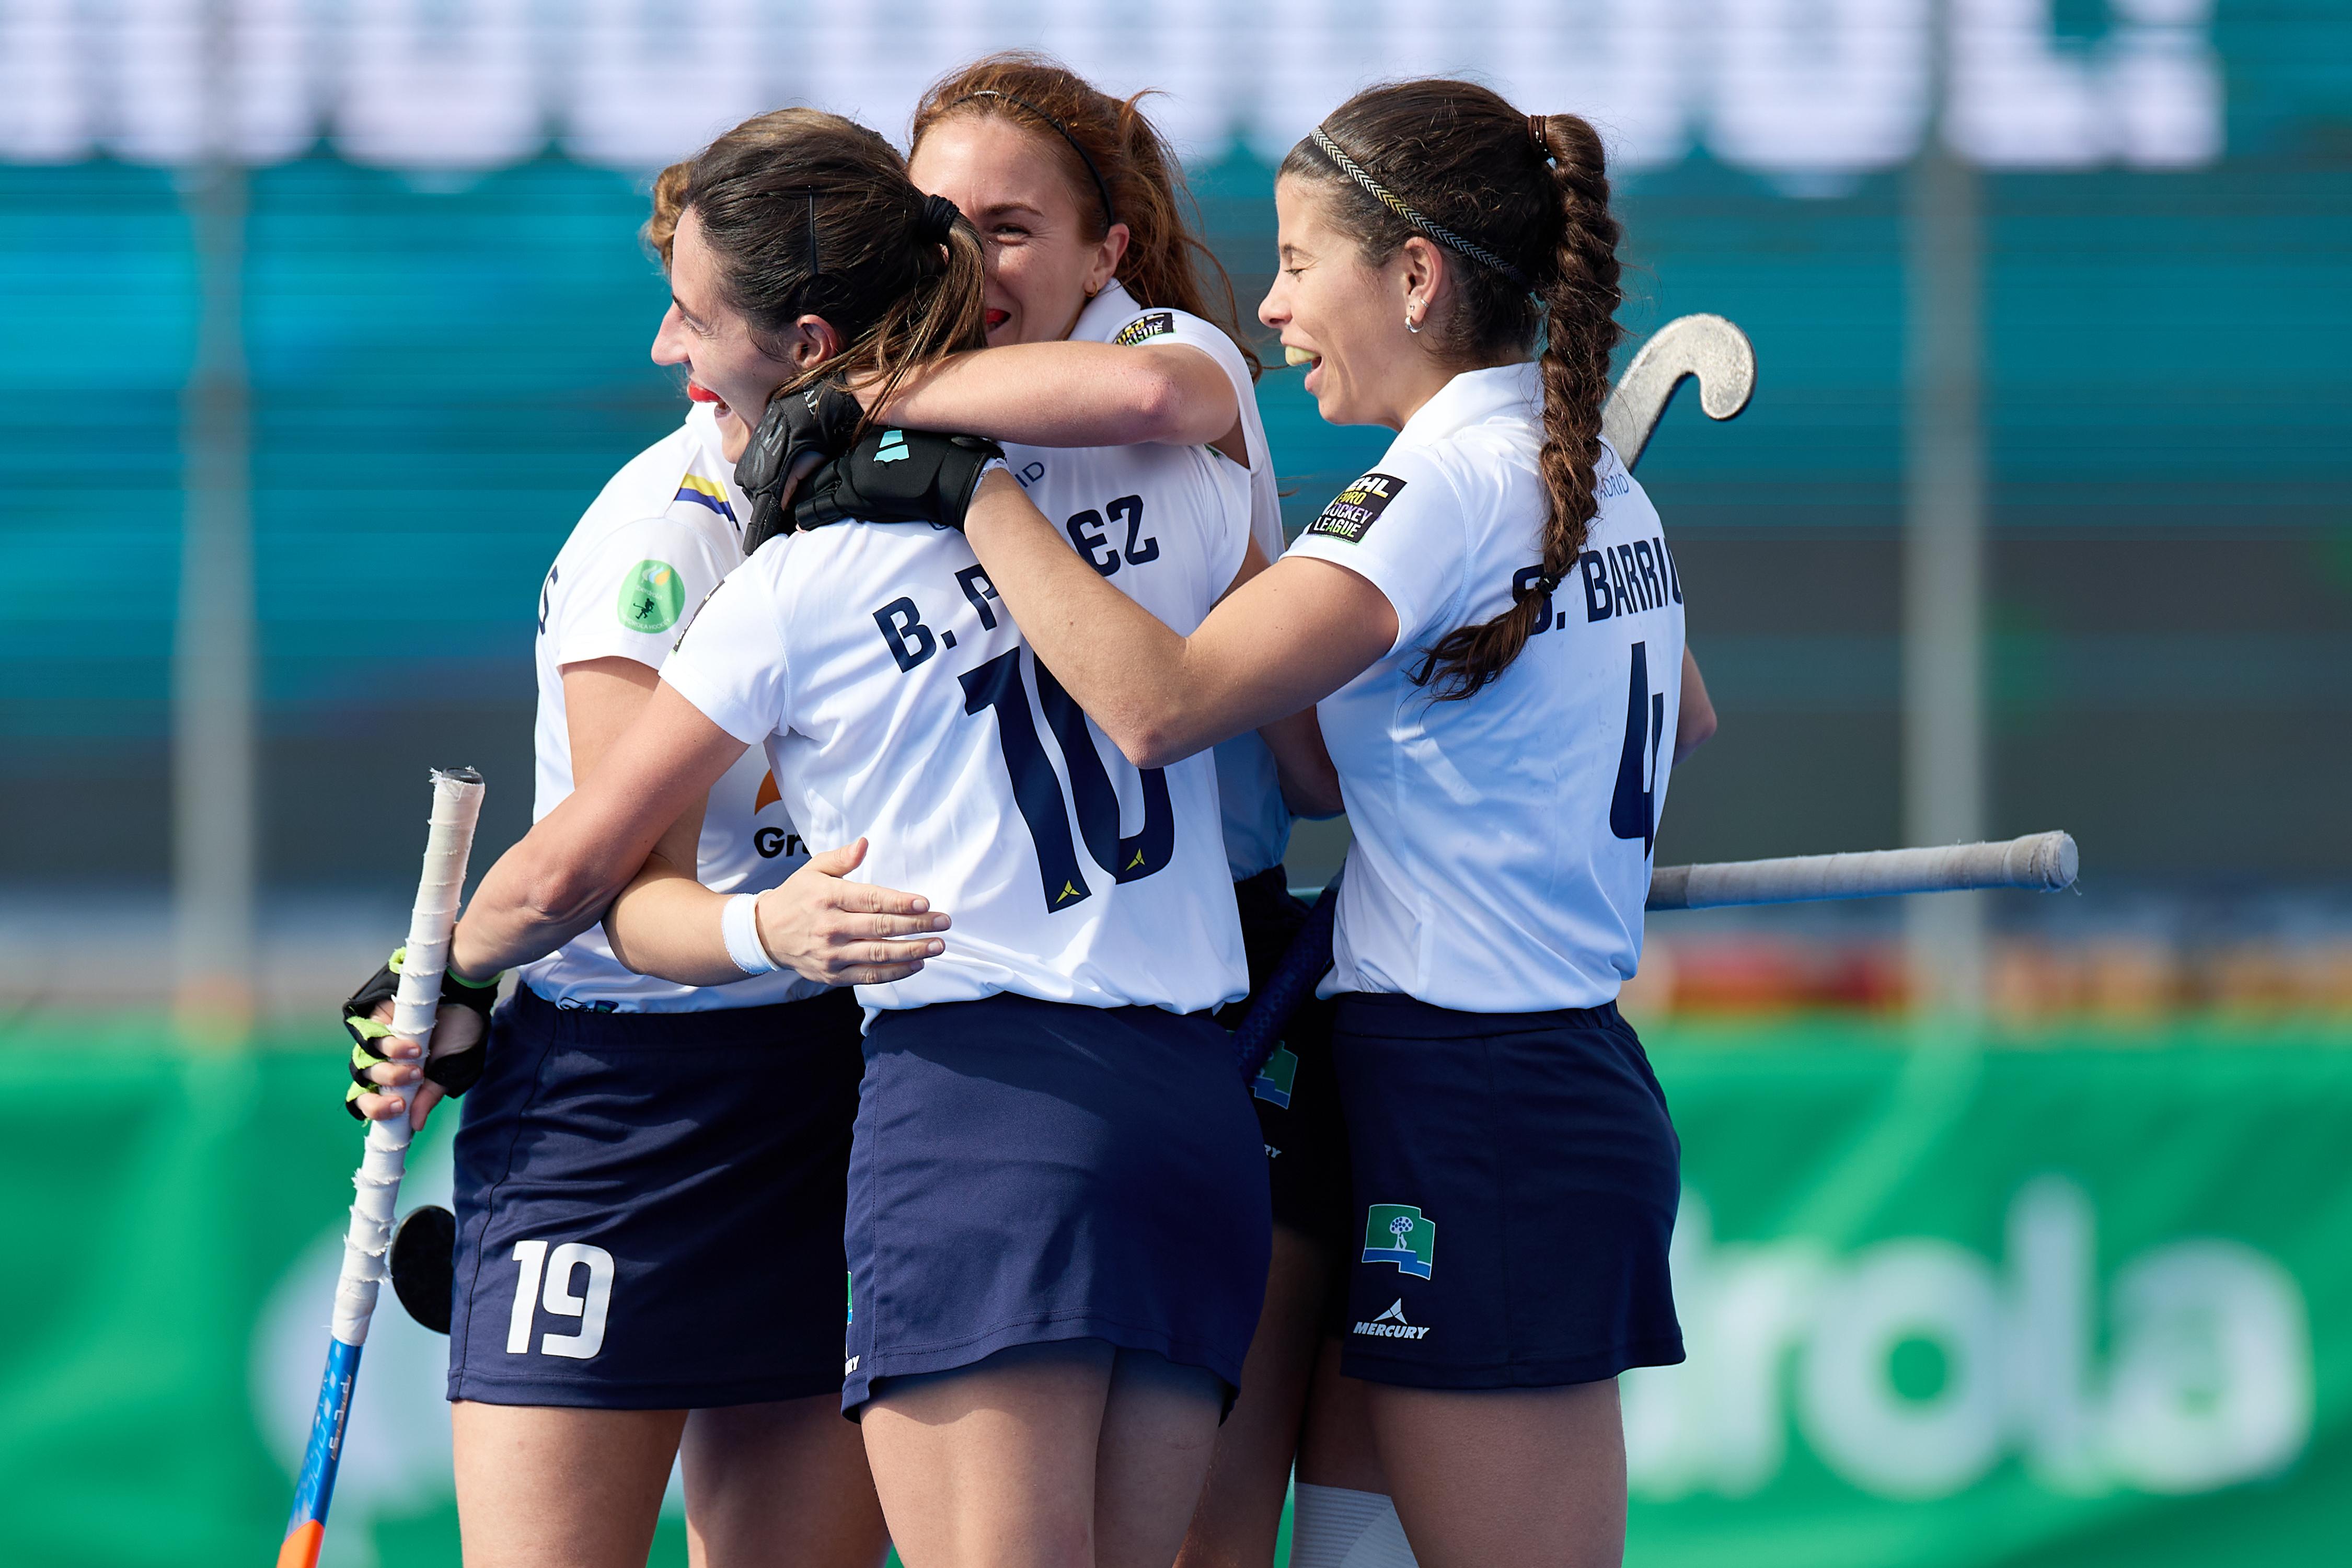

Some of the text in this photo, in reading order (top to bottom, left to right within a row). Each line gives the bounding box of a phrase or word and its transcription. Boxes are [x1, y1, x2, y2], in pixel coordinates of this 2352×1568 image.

[1345, 476, 1389, 499] EHL
[1594, 474, 1629, 500] ADRID
[1313, 516, 1362, 538] LEAGUE
[872, 494, 1159, 673] B. PEZ
[1610, 641, 1664, 861] 4
[958, 646, 1174, 914] 10
[754, 827, 811, 859] Gr
[506, 1240, 615, 1359] 19
[1353, 1321, 1431, 1340] MERCURY
